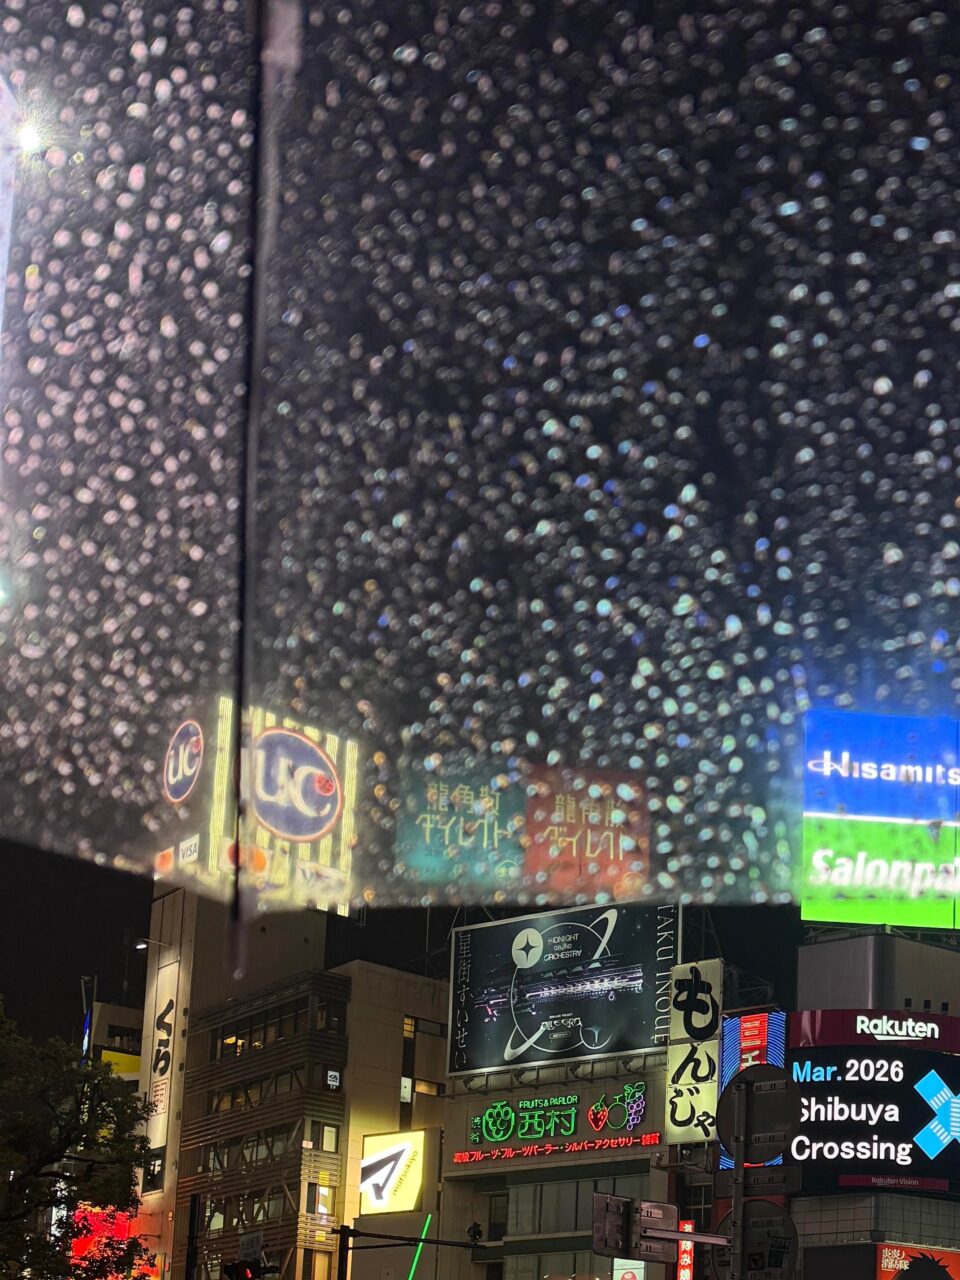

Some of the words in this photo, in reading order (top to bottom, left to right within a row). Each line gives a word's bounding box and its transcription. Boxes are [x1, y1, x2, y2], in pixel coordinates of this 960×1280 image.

[856, 1015, 939, 1041] Rakuten
[668, 966, 720, 1138] もんじゃ
[516, 1106, 578, 1140] 西村
[800, 1096, 900, 1126] Shibuya
[790, 1134, 913, 1166] Crossing
[872, 1176, 899, 1187] Rakuten
[899, 1177, 919, 1186] Vision
